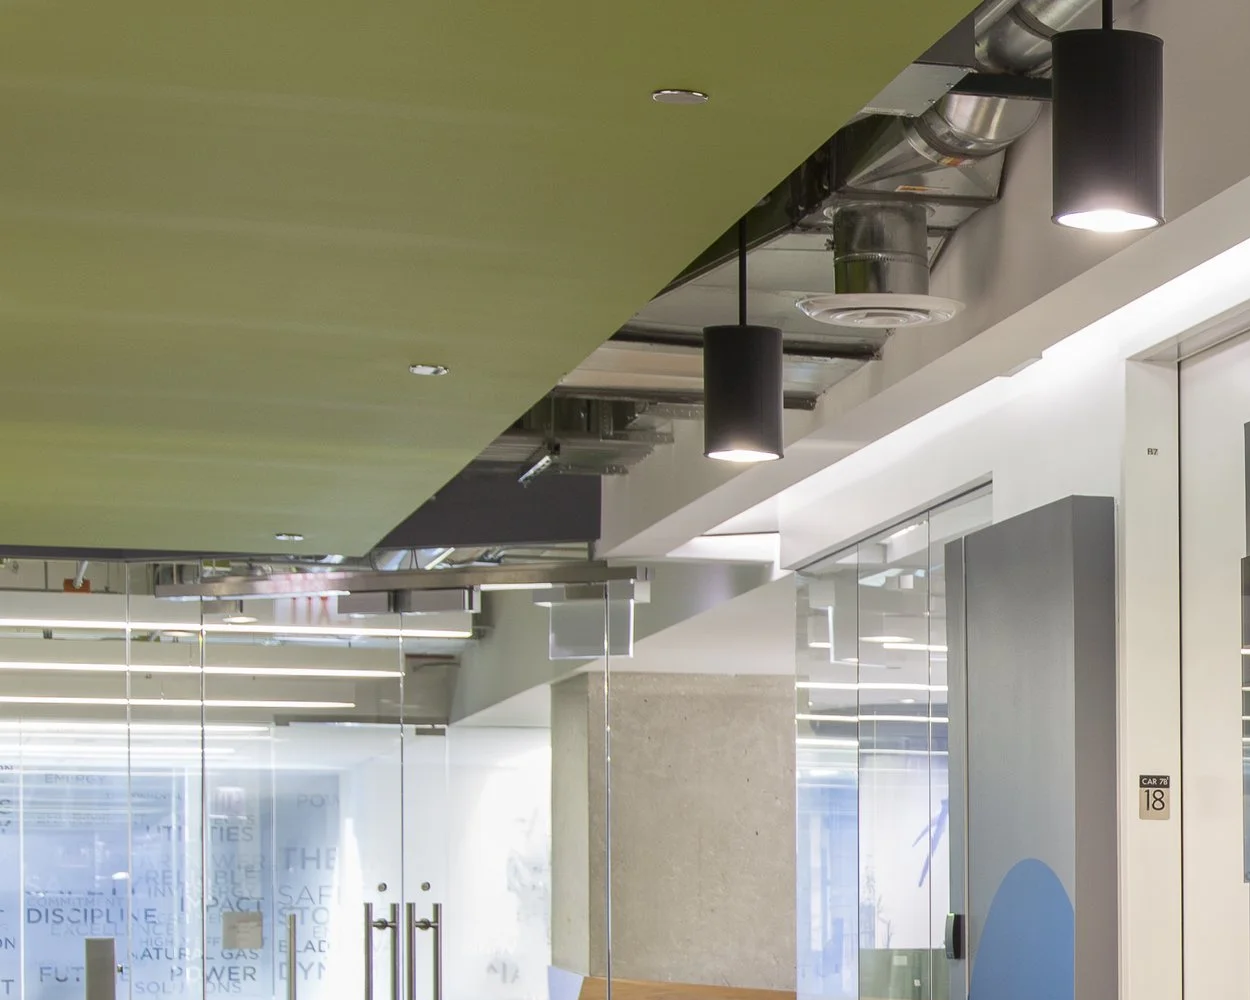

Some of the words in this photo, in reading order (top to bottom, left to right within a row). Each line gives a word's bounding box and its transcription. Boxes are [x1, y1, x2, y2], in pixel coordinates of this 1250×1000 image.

[1144, 789, 1166, 811] 18
[145, 824, 255, 843] UTITIES
[145, 869, 259, 886] RELBLE
[26, 907, 157, 924] DISCIPLINE
[39, 965, 131, 983] FUTE
[170, 965, 257, 982] POWER
